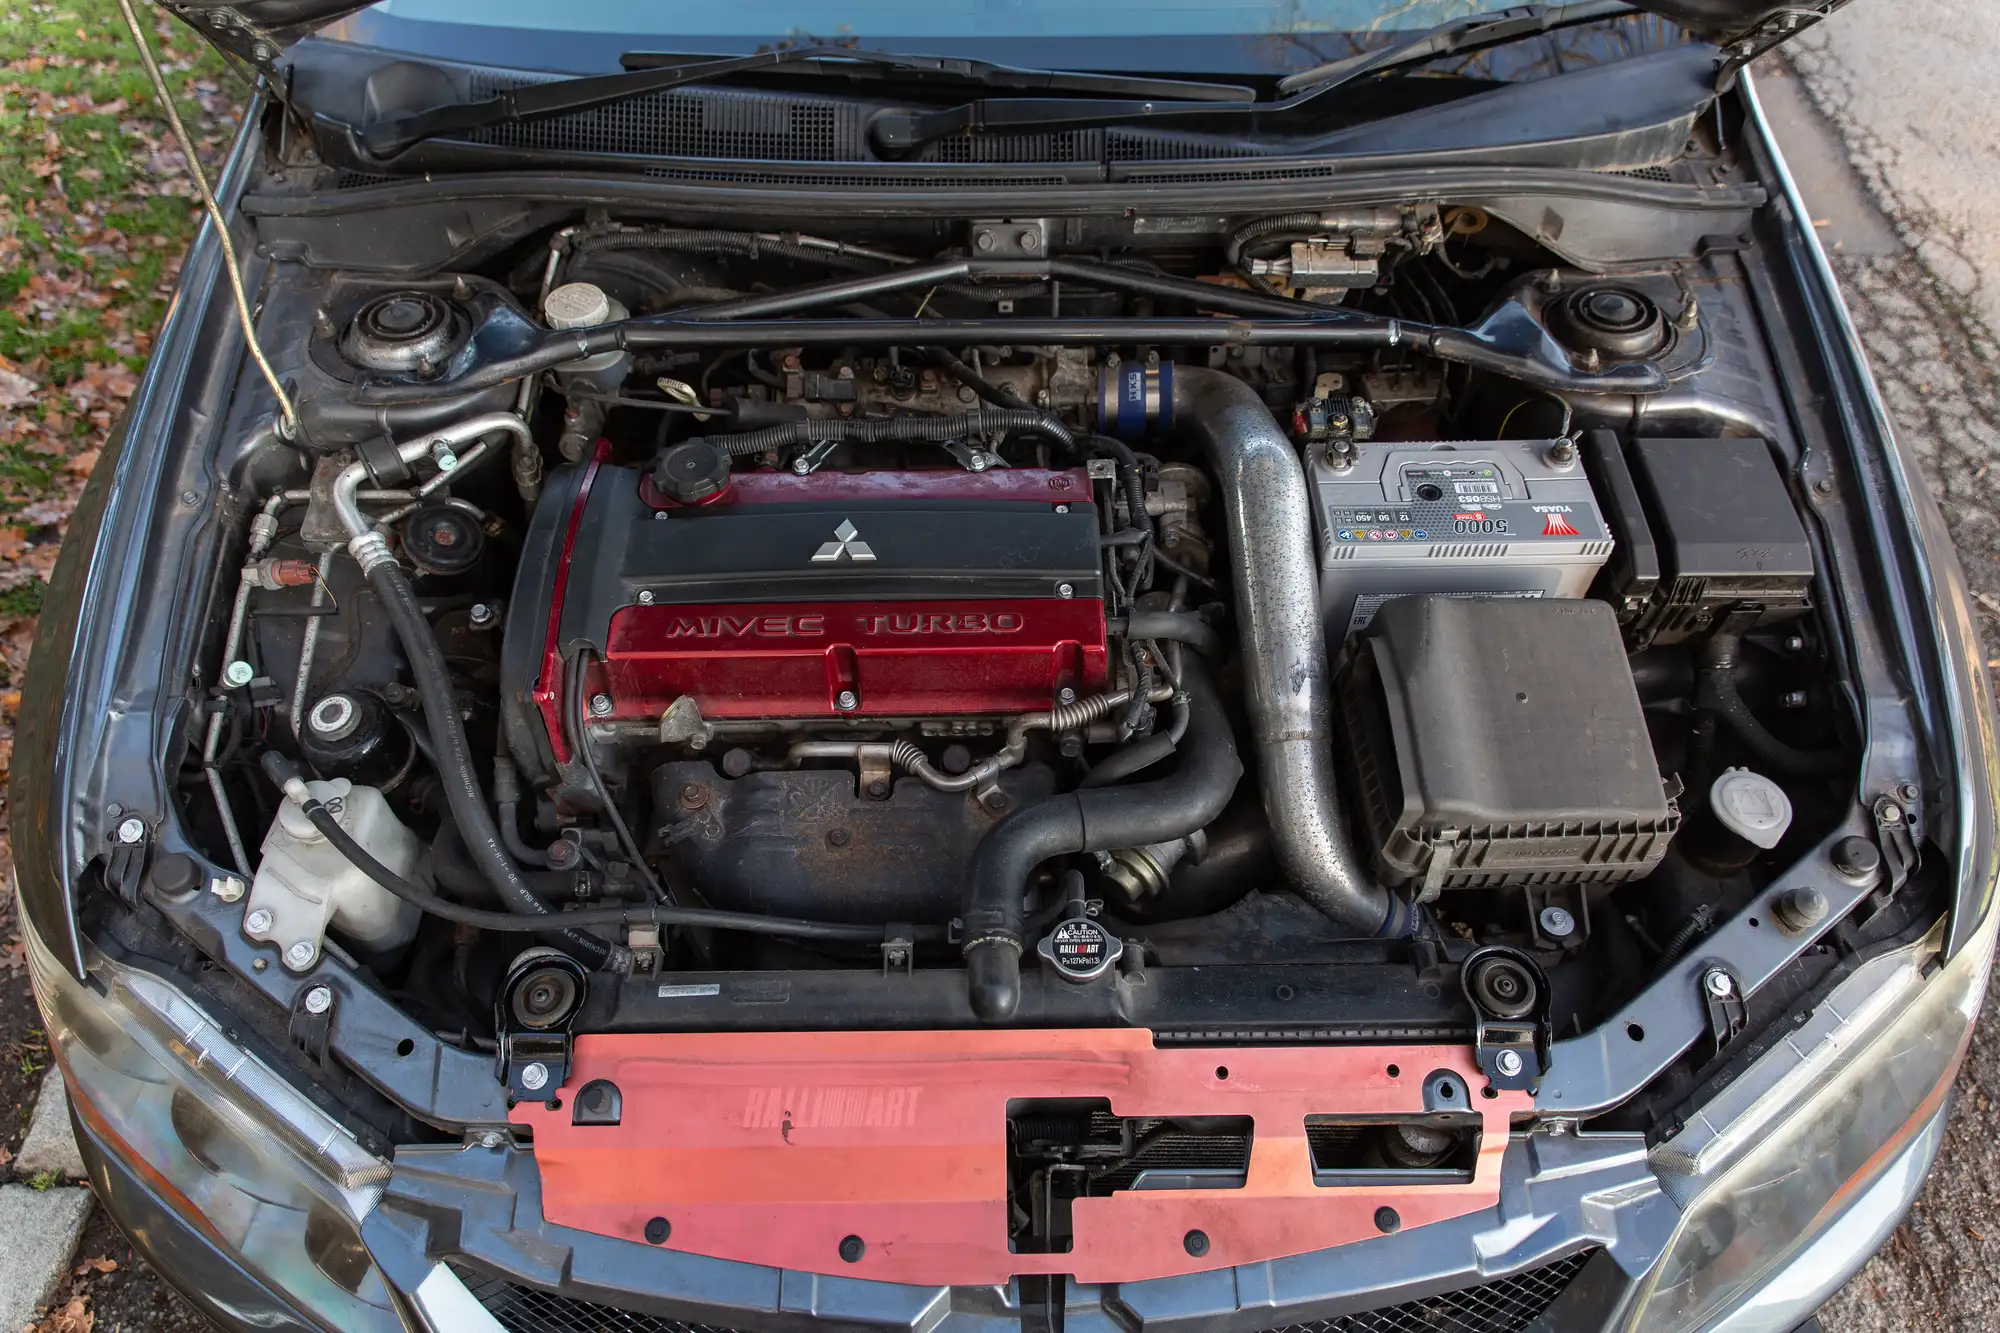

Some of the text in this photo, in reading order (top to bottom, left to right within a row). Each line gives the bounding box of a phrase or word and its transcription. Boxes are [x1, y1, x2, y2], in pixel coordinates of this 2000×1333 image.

[1129, 372, 1137, 401] HKS
[1457, 495, 1500, 503] HSB053
[1532, 505, 1573, 513] YUASA
[1453, 519, 1508, 534] 5000
[666, 612, 1024, 639] MIVEC TURBO
[579, 937, 607, 955] NICHIRIN
